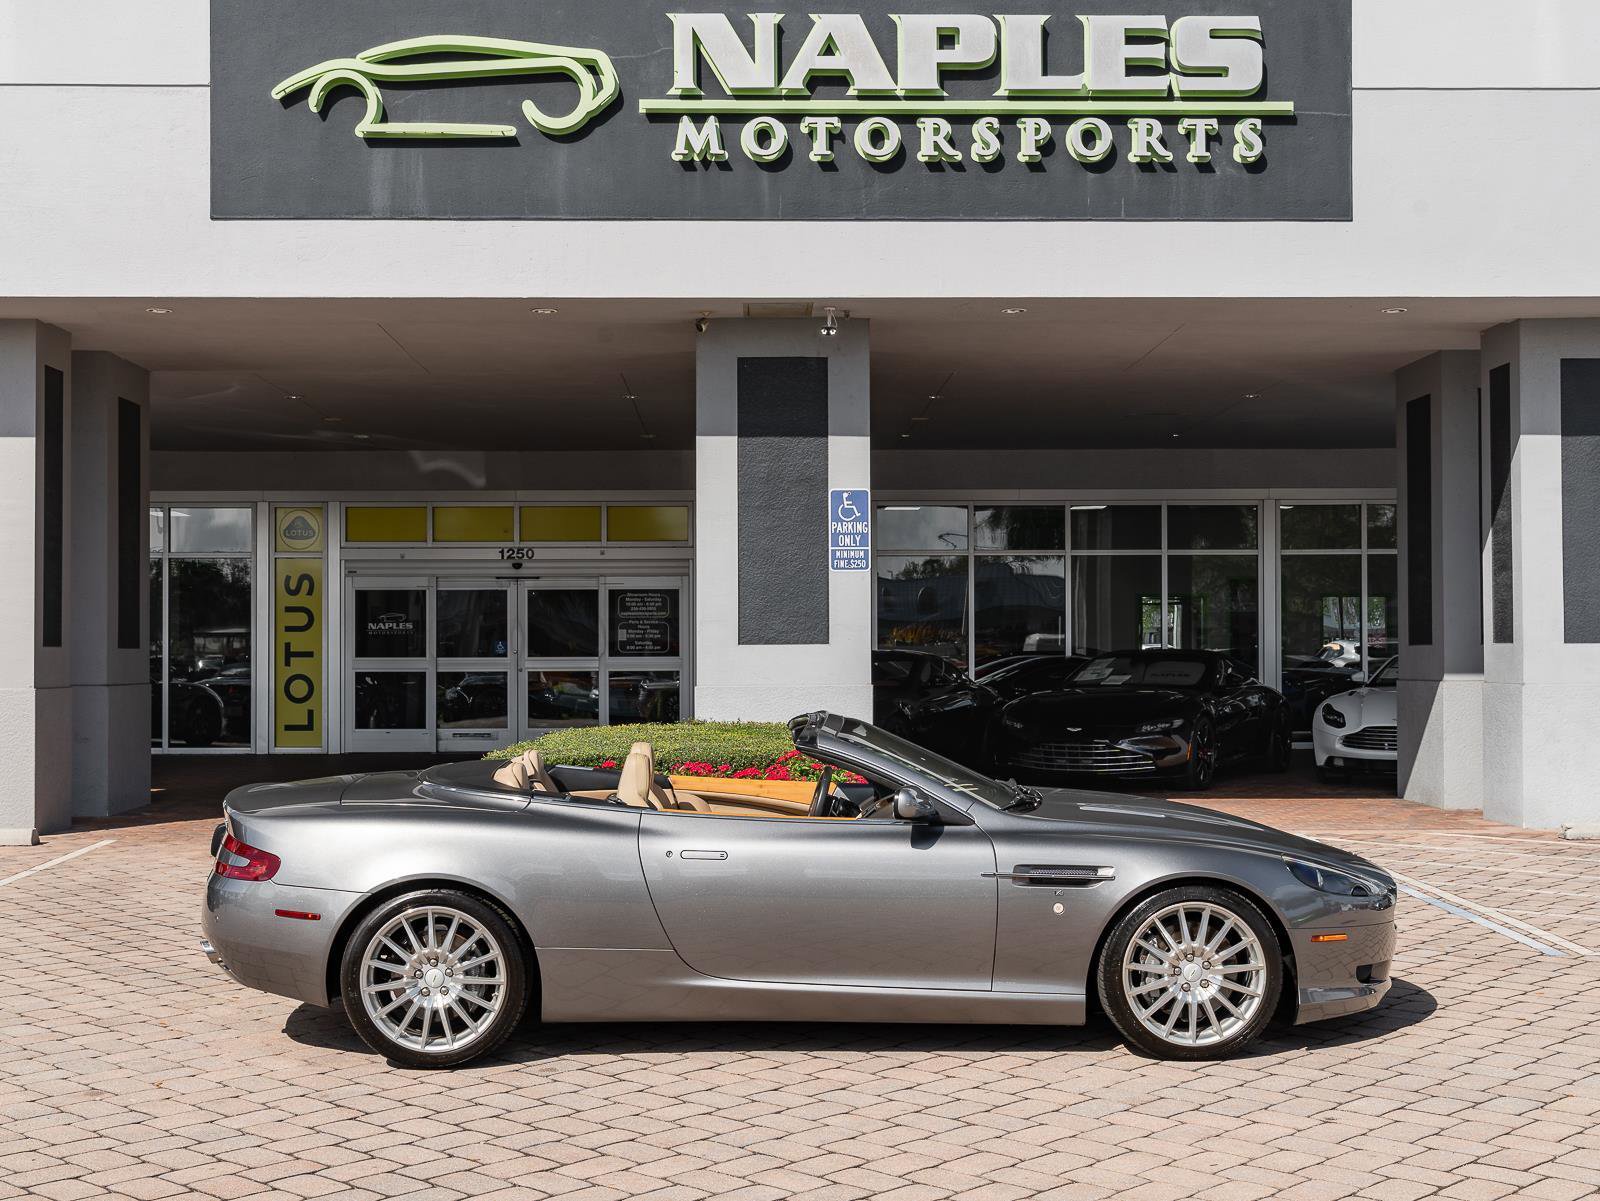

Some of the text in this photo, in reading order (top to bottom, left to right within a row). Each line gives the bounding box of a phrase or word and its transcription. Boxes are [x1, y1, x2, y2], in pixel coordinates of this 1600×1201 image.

[667, 13, 1264, 97] NAPLES
[671, 116, 1264, 163] MOTORSPORTS
[285, 529, 314, 537] LOTUS
[831, 521, 868, 534] PARKING
[838, 534, 861, 547] ONLY
[498, 547, 535, 560] 1250
[835, 550, 864, 559] MINIMUM
[834, 560, 866, 568] FINE $250
[368, 622, 413, 630] NAPLES
[283, 573, 315, 732] LOTUS
